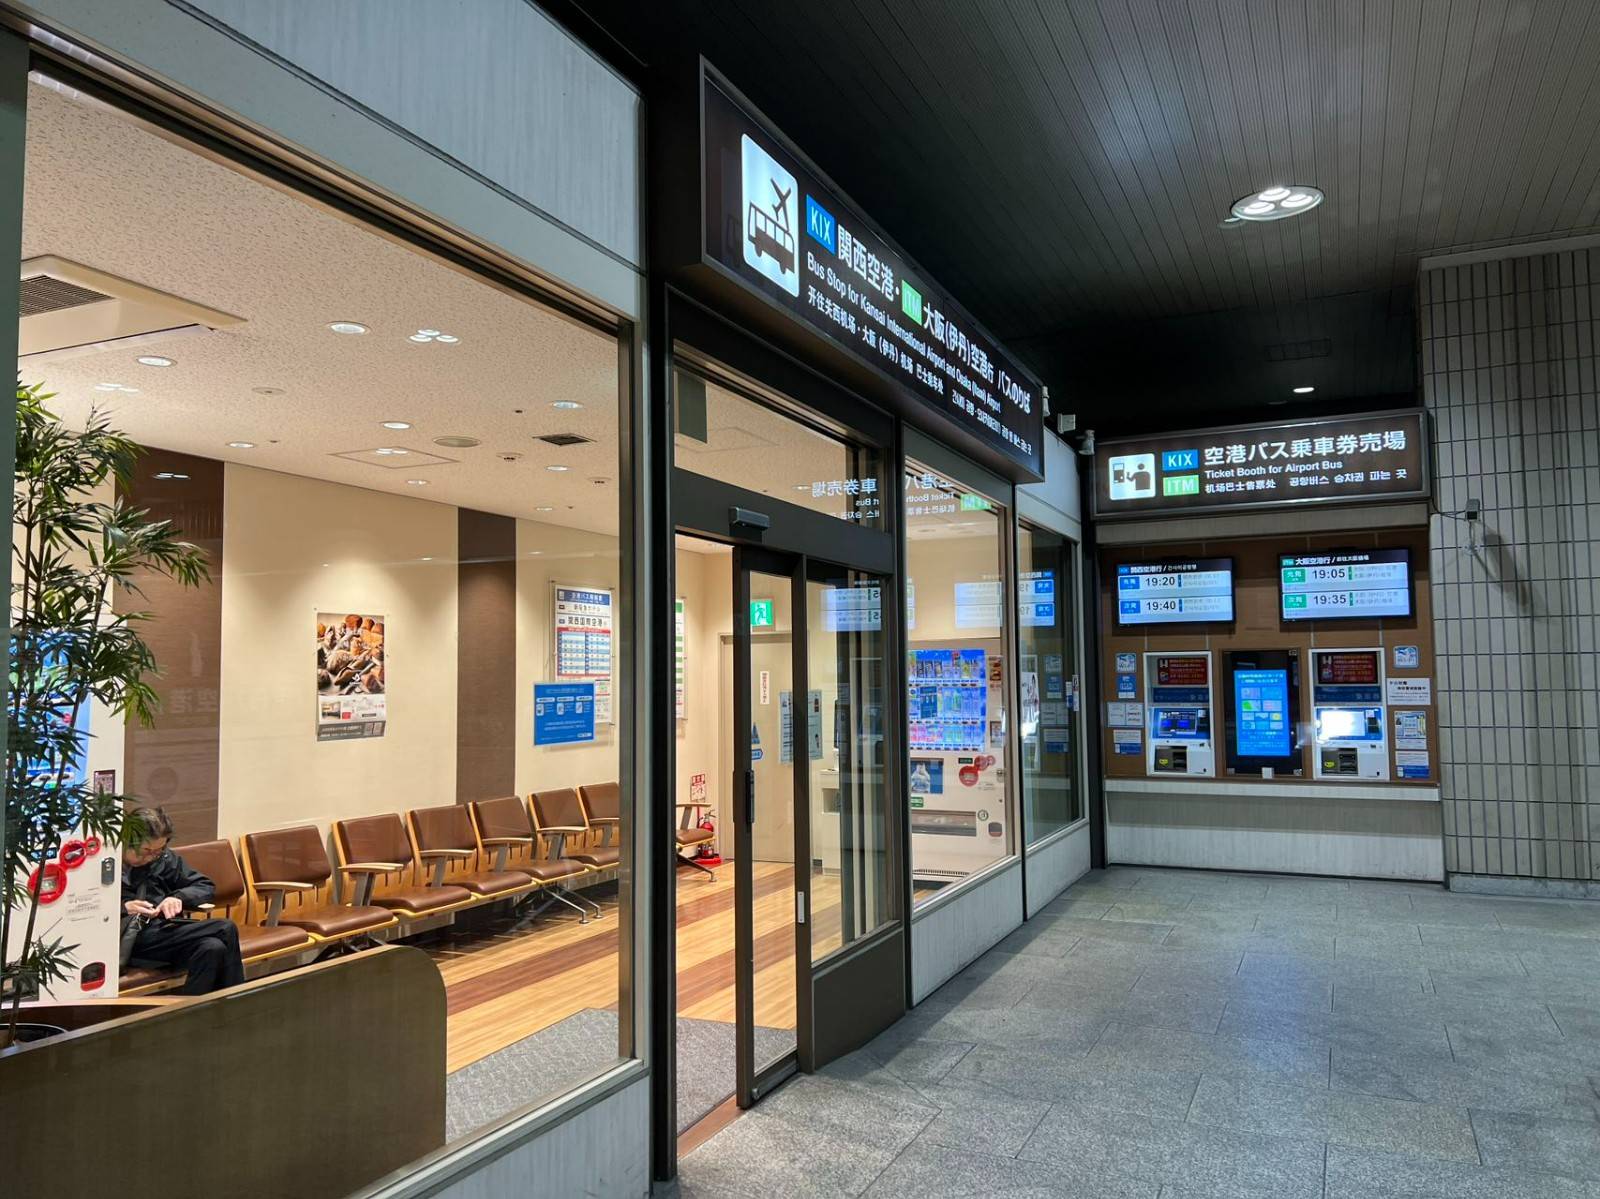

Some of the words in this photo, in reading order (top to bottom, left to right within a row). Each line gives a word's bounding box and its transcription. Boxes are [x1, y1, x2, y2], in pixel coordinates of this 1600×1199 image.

[807, 251, 825, 280] Bus
[827, 267, 847, 298] Stop
[848, 283, 860, 305] for
[860, 293, 886, 326] Kansai
[887, 314, 926, 357] International
[927, 345, 945, 371] Airport
[811, 206, 831, 245] KIX
[998, 369, 1031, 414] バスのりば
[1168, 453, 1193, 467] KIX
[1204, 430, 1406, 466] 空港バス乗車券売場
[1204, 470, 1234, 480] Ticket
[1236, 465, 1266, 477] Booth
[1269, 464, 1283, 474] for
[1285, 461, 1320, 474] Airport
[1322, 460, 1343, 470] Bus
[1396, 468, 1408, 479] 곳
[1167, 480, 1195, 494] ITM
[1312, 569, 1346, 579] 19:05
[1145, 576, 1175, 586] 19:20
[1313, 594, 1347, 604] 19:35
[1147, 601, 1176, 610] 19:40
